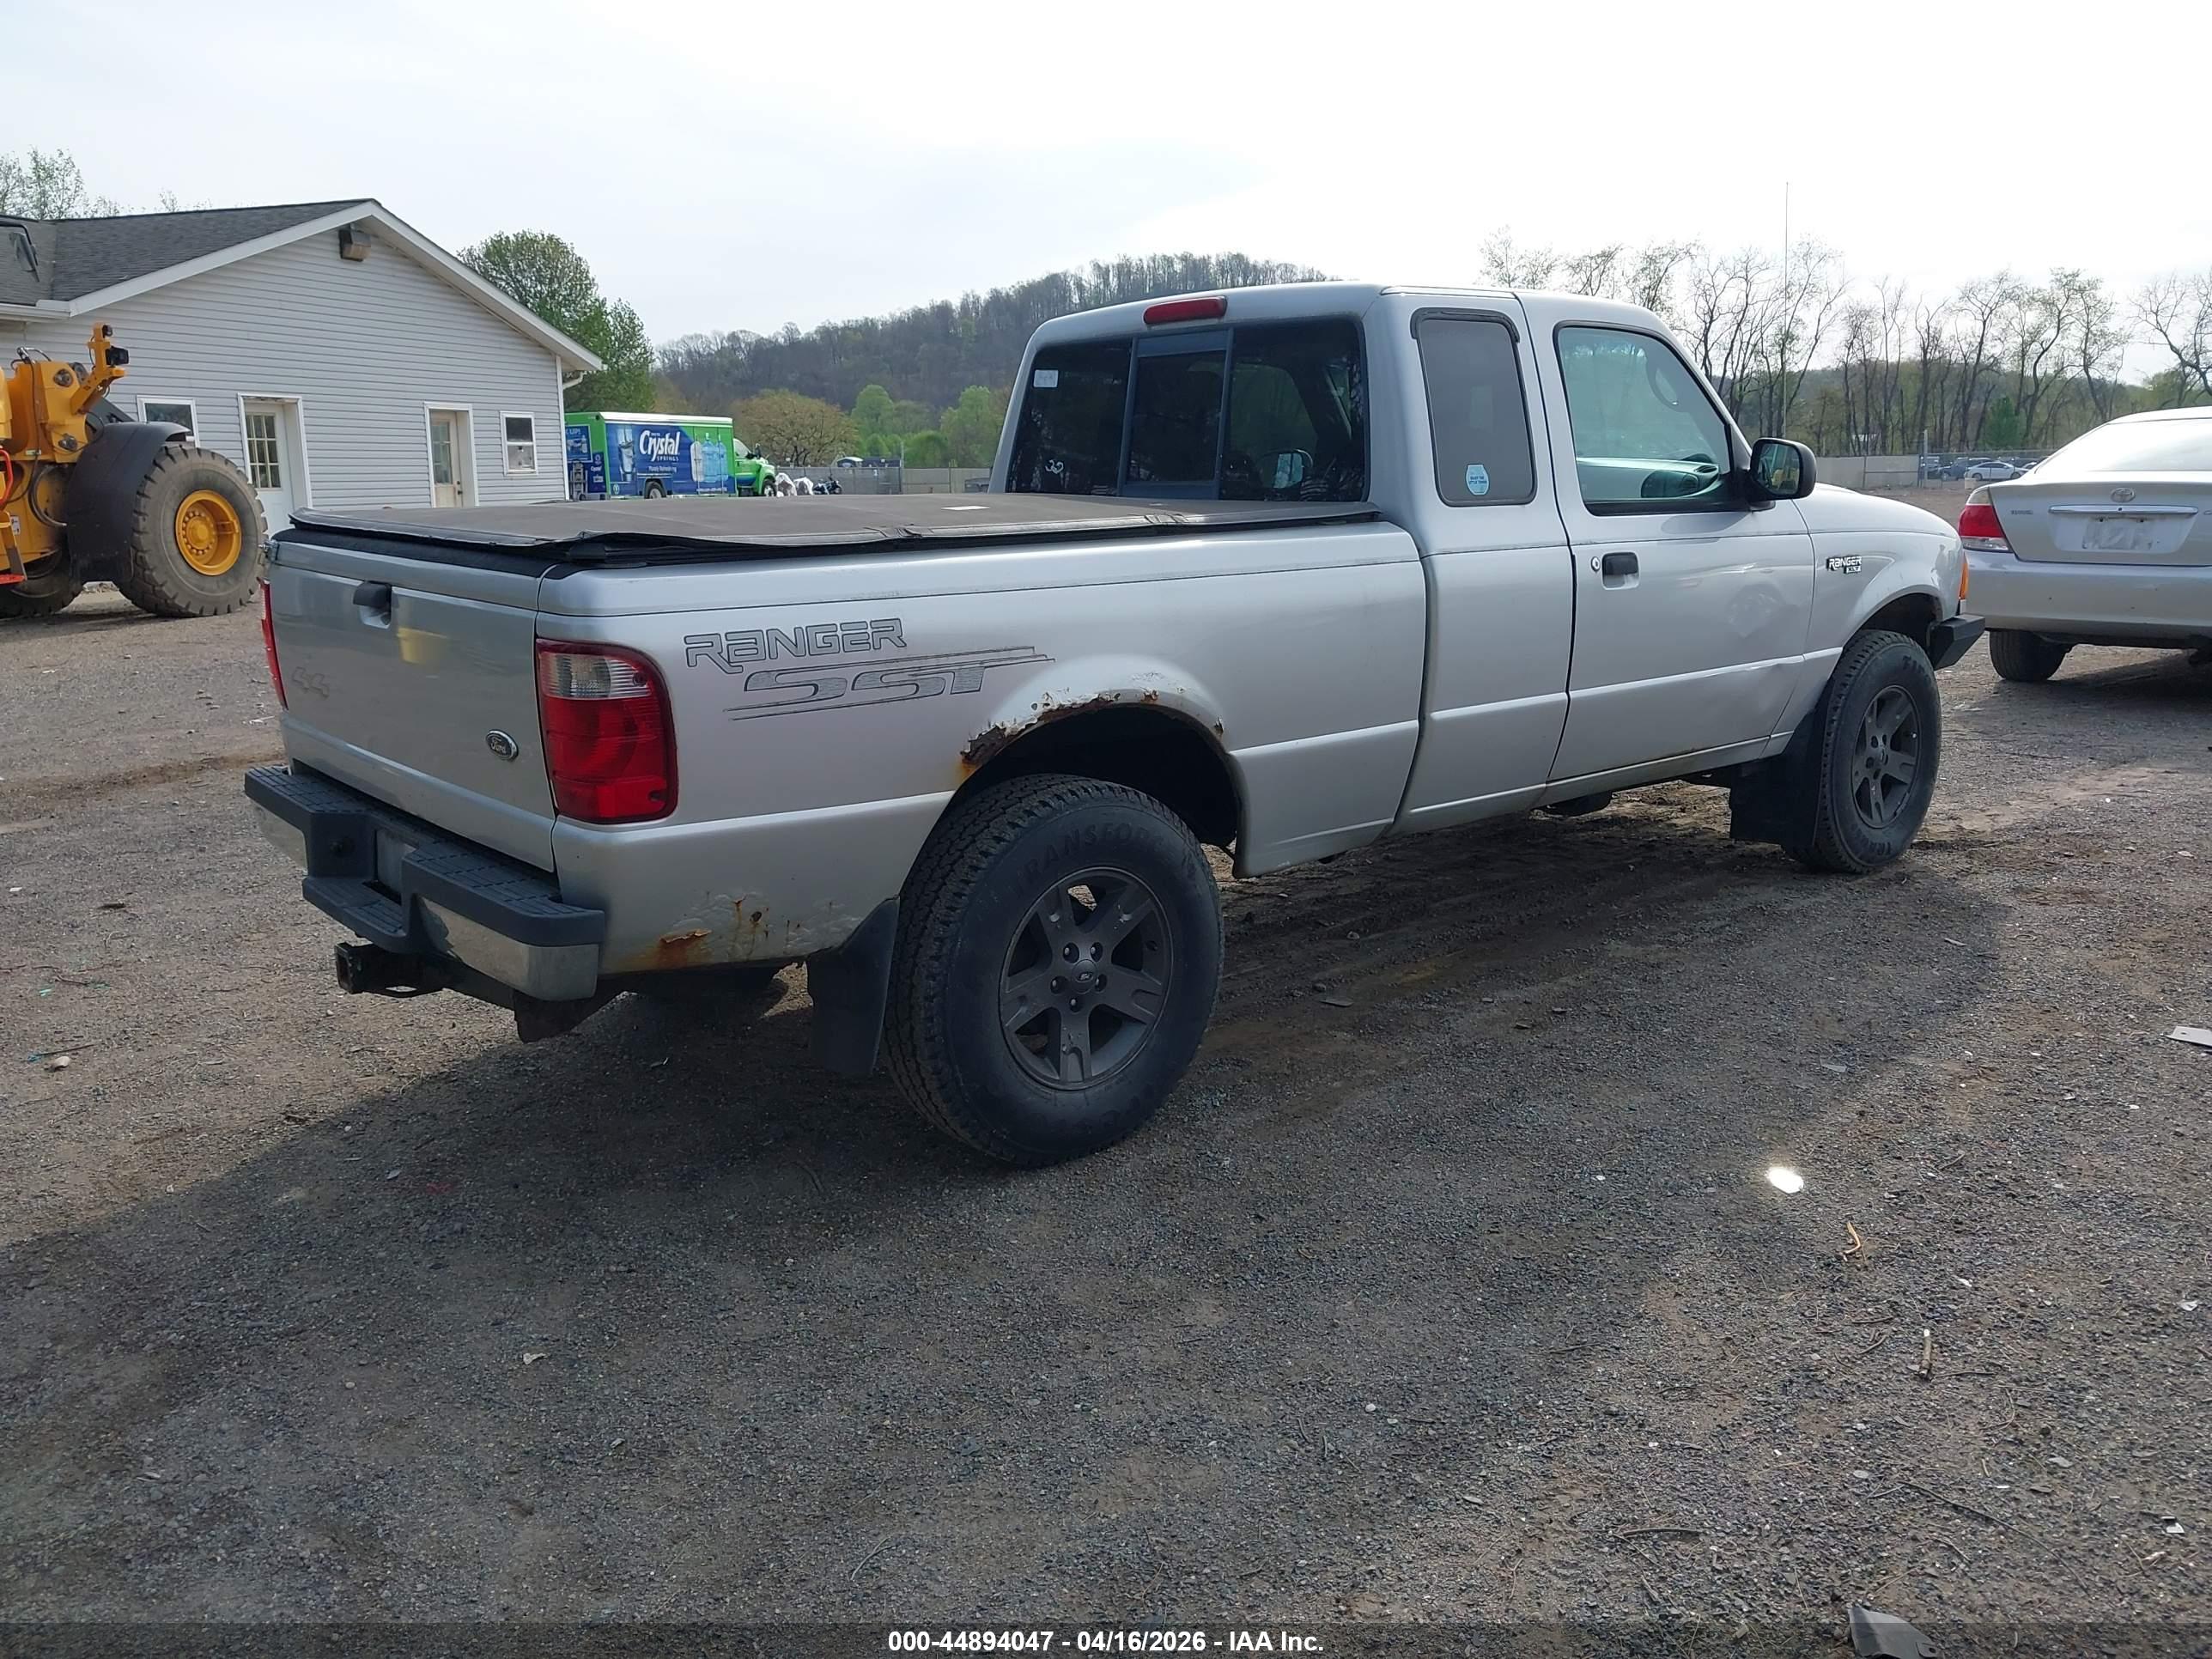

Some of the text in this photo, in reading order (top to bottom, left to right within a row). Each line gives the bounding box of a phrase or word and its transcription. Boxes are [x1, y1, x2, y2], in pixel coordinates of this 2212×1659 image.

[639, 429, 681, 462] Crystal
[1828, 556, 1863, 570] RANGER
[684, 617, 908, 674] RANGER
